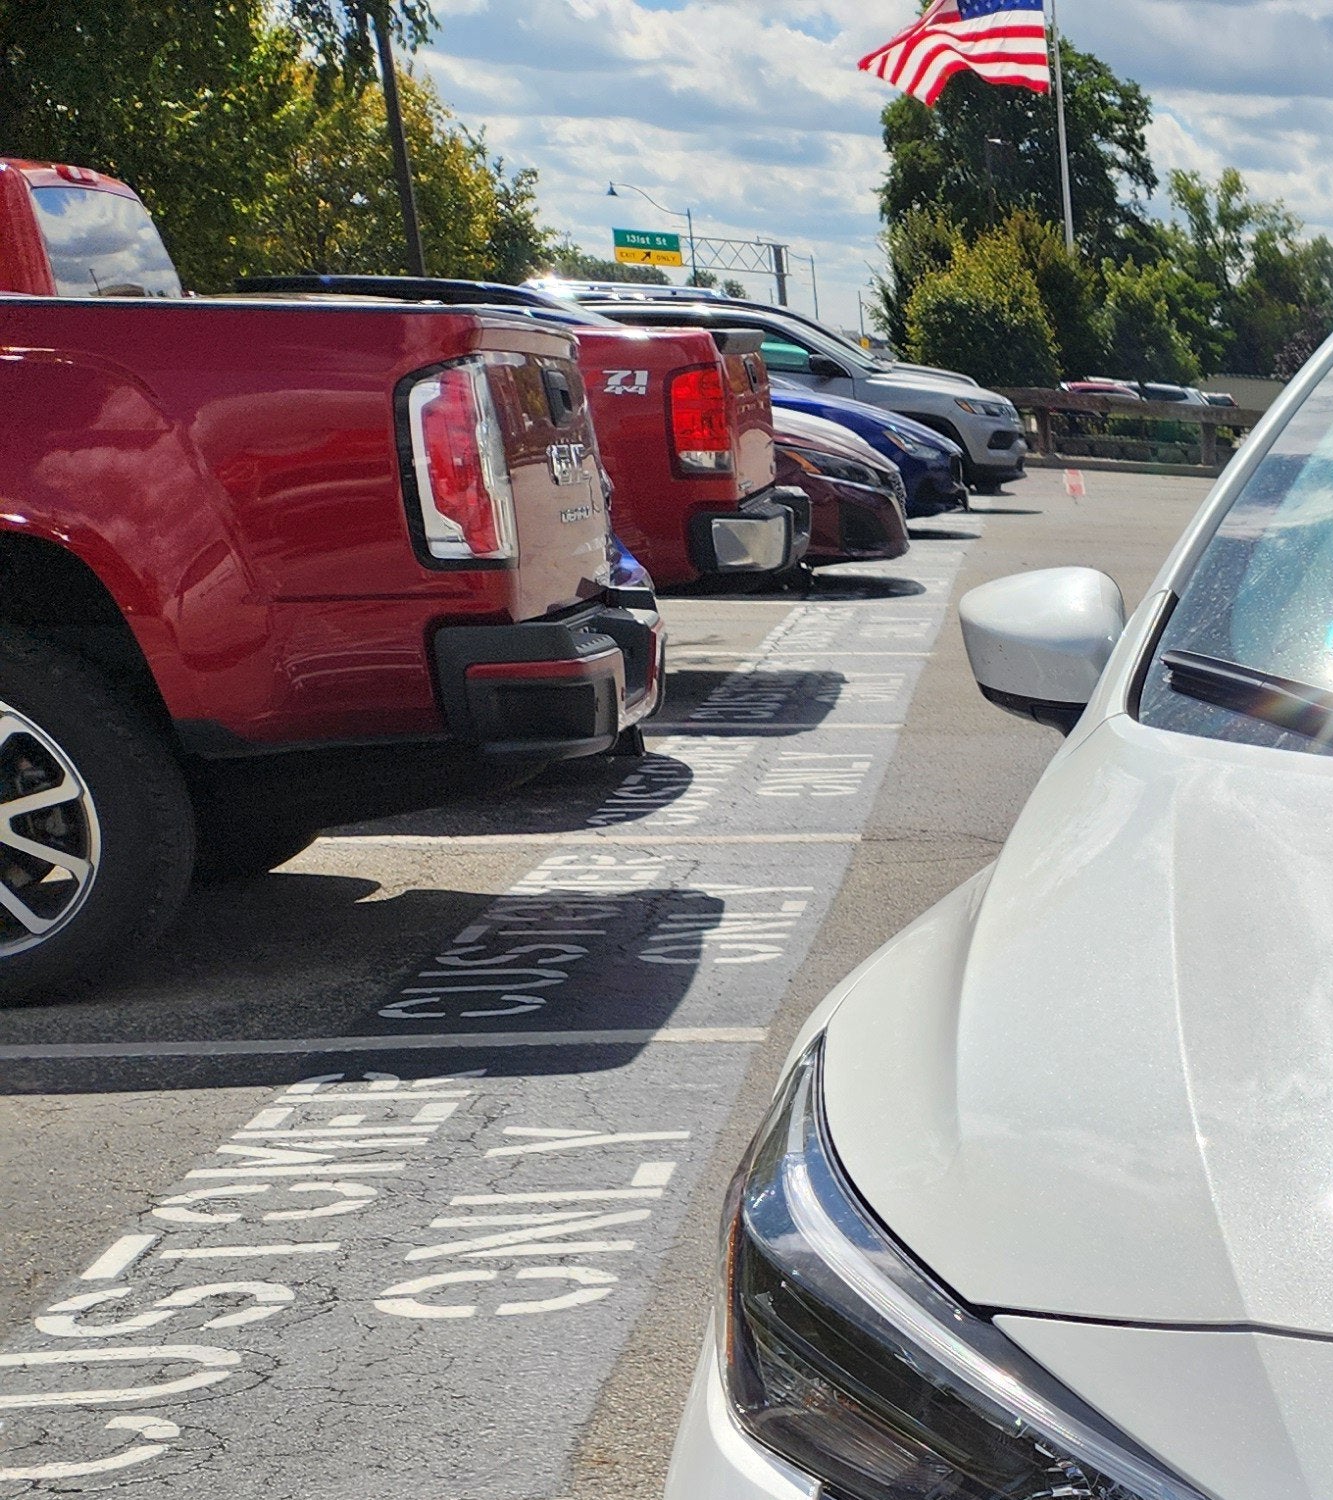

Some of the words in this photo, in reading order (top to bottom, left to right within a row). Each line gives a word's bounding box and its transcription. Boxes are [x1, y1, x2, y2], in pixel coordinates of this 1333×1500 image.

[626, 234, 650, 245] 131st
[656, 237, 667, 246] St
[756, 751, 873, 797] ONLY
[378, 854, 675, 1019] CUSTOMER
[638, 883, 814, 964] ONLY
[374, 1126, 691, 1319] ONLY
